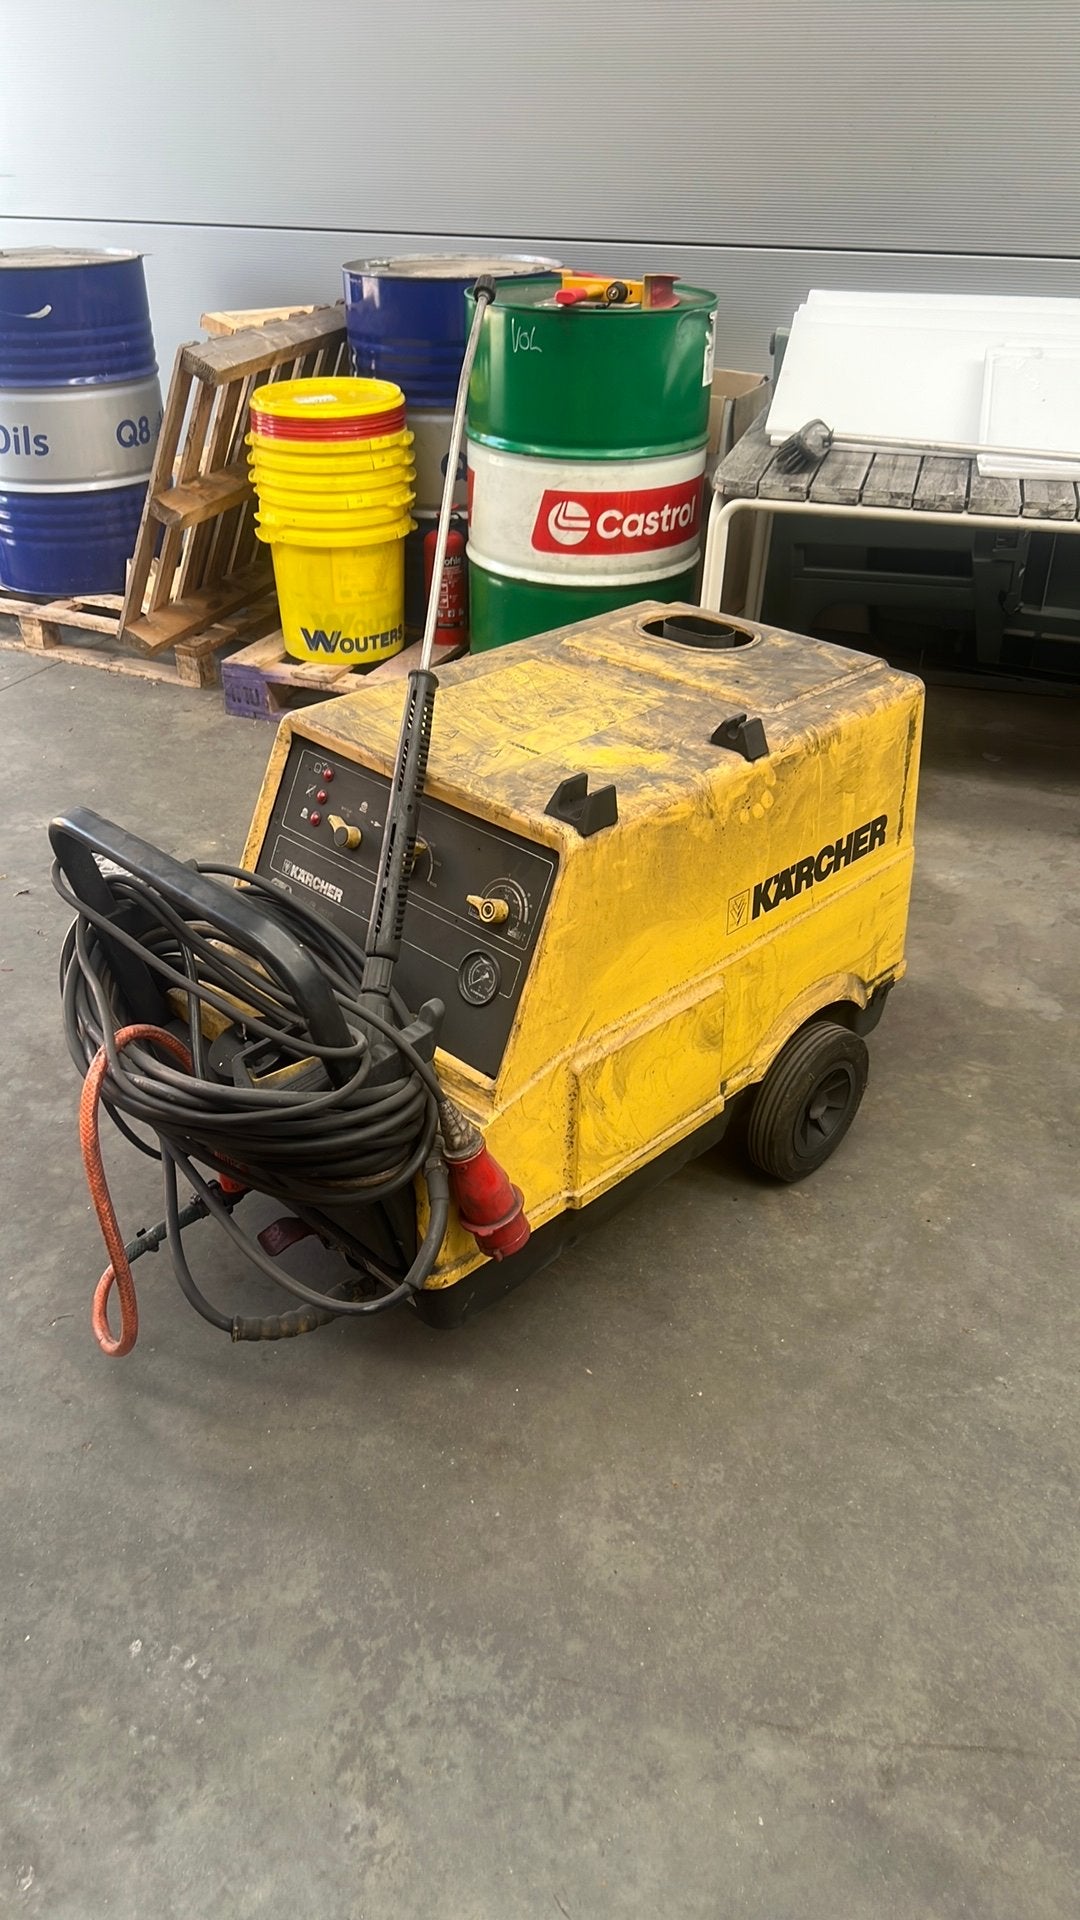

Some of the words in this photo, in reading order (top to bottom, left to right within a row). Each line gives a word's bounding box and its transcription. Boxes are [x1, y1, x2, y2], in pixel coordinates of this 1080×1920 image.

[511, 317, 543, 353] VOL
[116, 416, 151, 449] Q8
[596, 494, 697, 540] Castrol
[301, 623, 403, 654] WOUTERS
[289, 863, 344, 903] KÄRCHER
[751, 814, 888, 920] KÄRCHER
